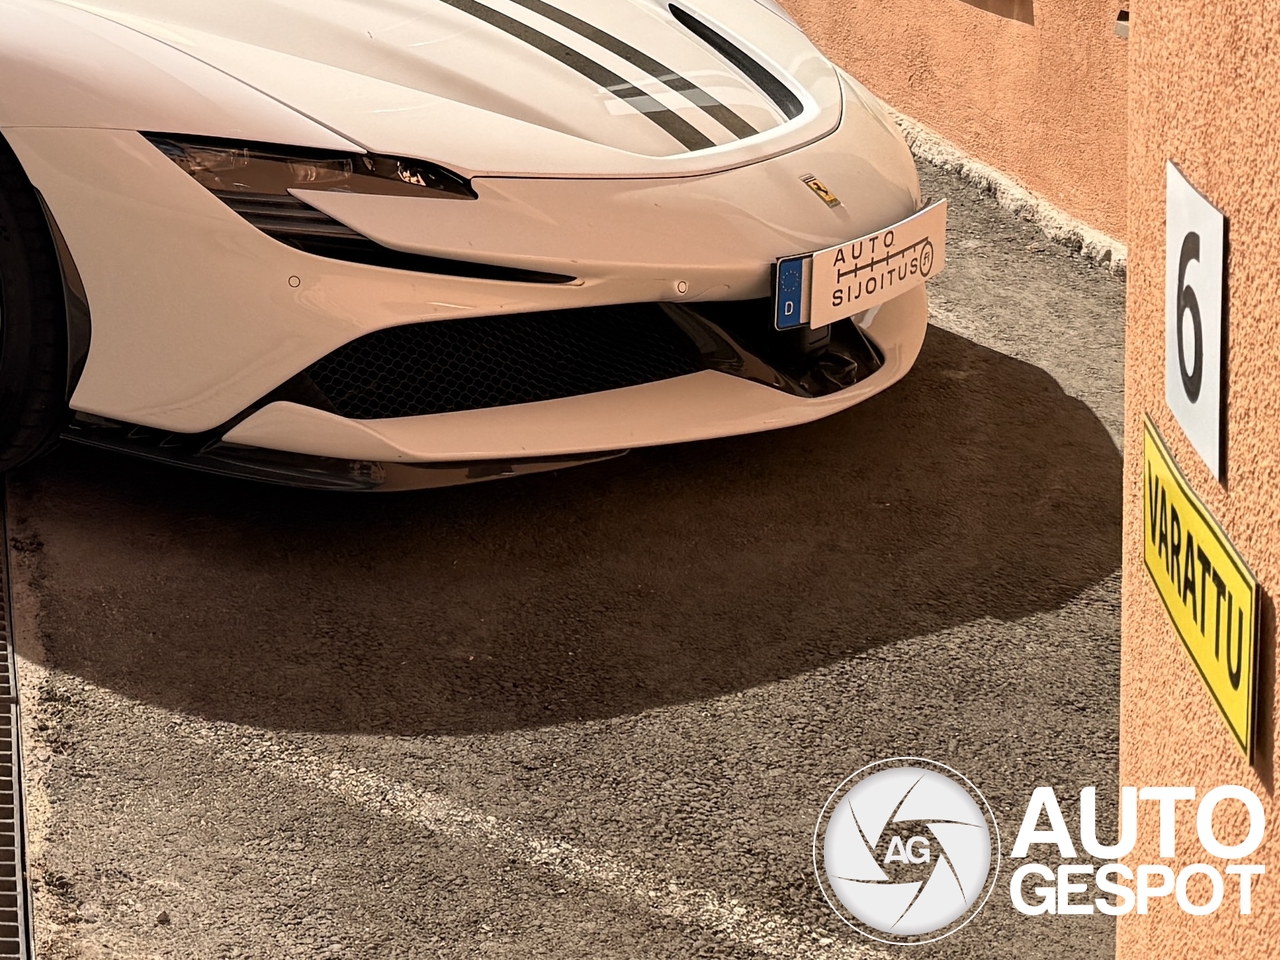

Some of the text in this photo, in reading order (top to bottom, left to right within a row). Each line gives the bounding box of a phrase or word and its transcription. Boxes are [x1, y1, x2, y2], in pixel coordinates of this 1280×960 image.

[833, 230, 895, 267] AUTO
[832, 257, 918, 307] SIJOITUS
[784, 301, 794, 315] D
[1176, 231, 1204, 404] 6
[1147, 474, 1245, 692] VARATTU
